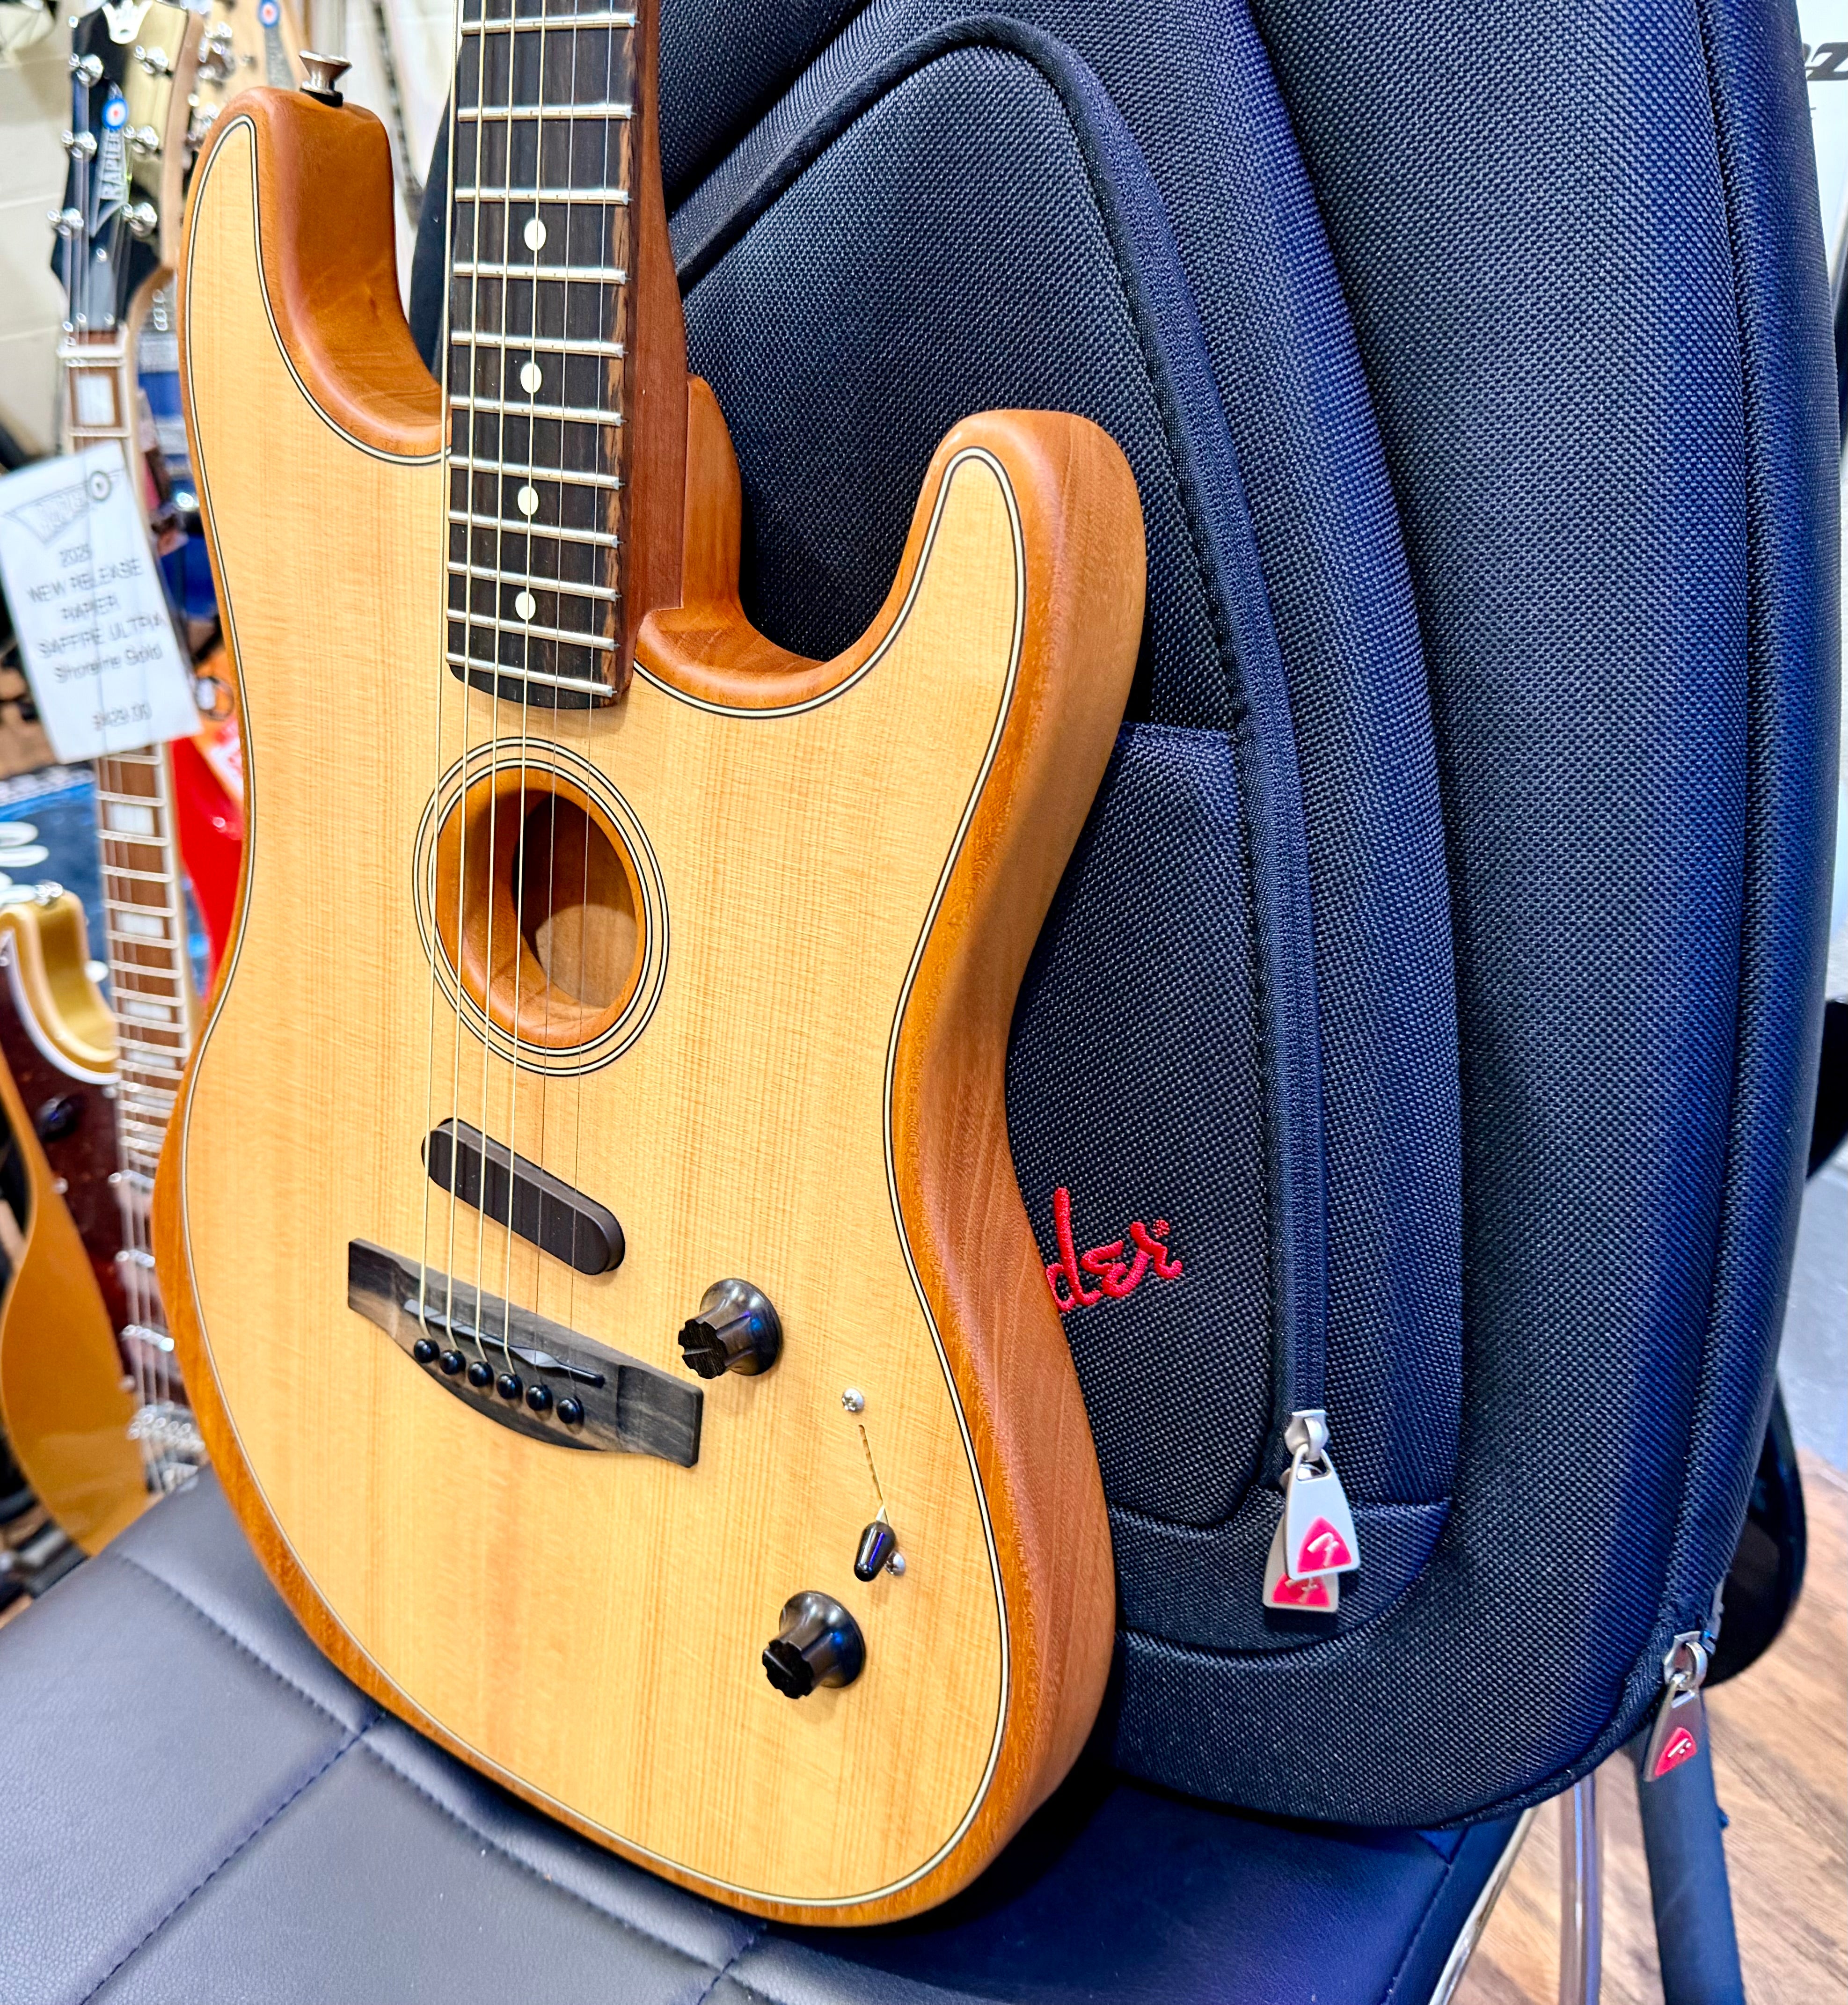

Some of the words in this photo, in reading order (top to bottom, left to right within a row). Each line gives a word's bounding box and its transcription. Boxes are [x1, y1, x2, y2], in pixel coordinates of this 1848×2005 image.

[101, 129, 124, 200] RAPIER
[27, 580, 66, 603] NEW
[69, 558, 144, 591] RELEASE
[61, 594, 121, 621] RAPIER
[1045, 1187, 1183, 1312] der
